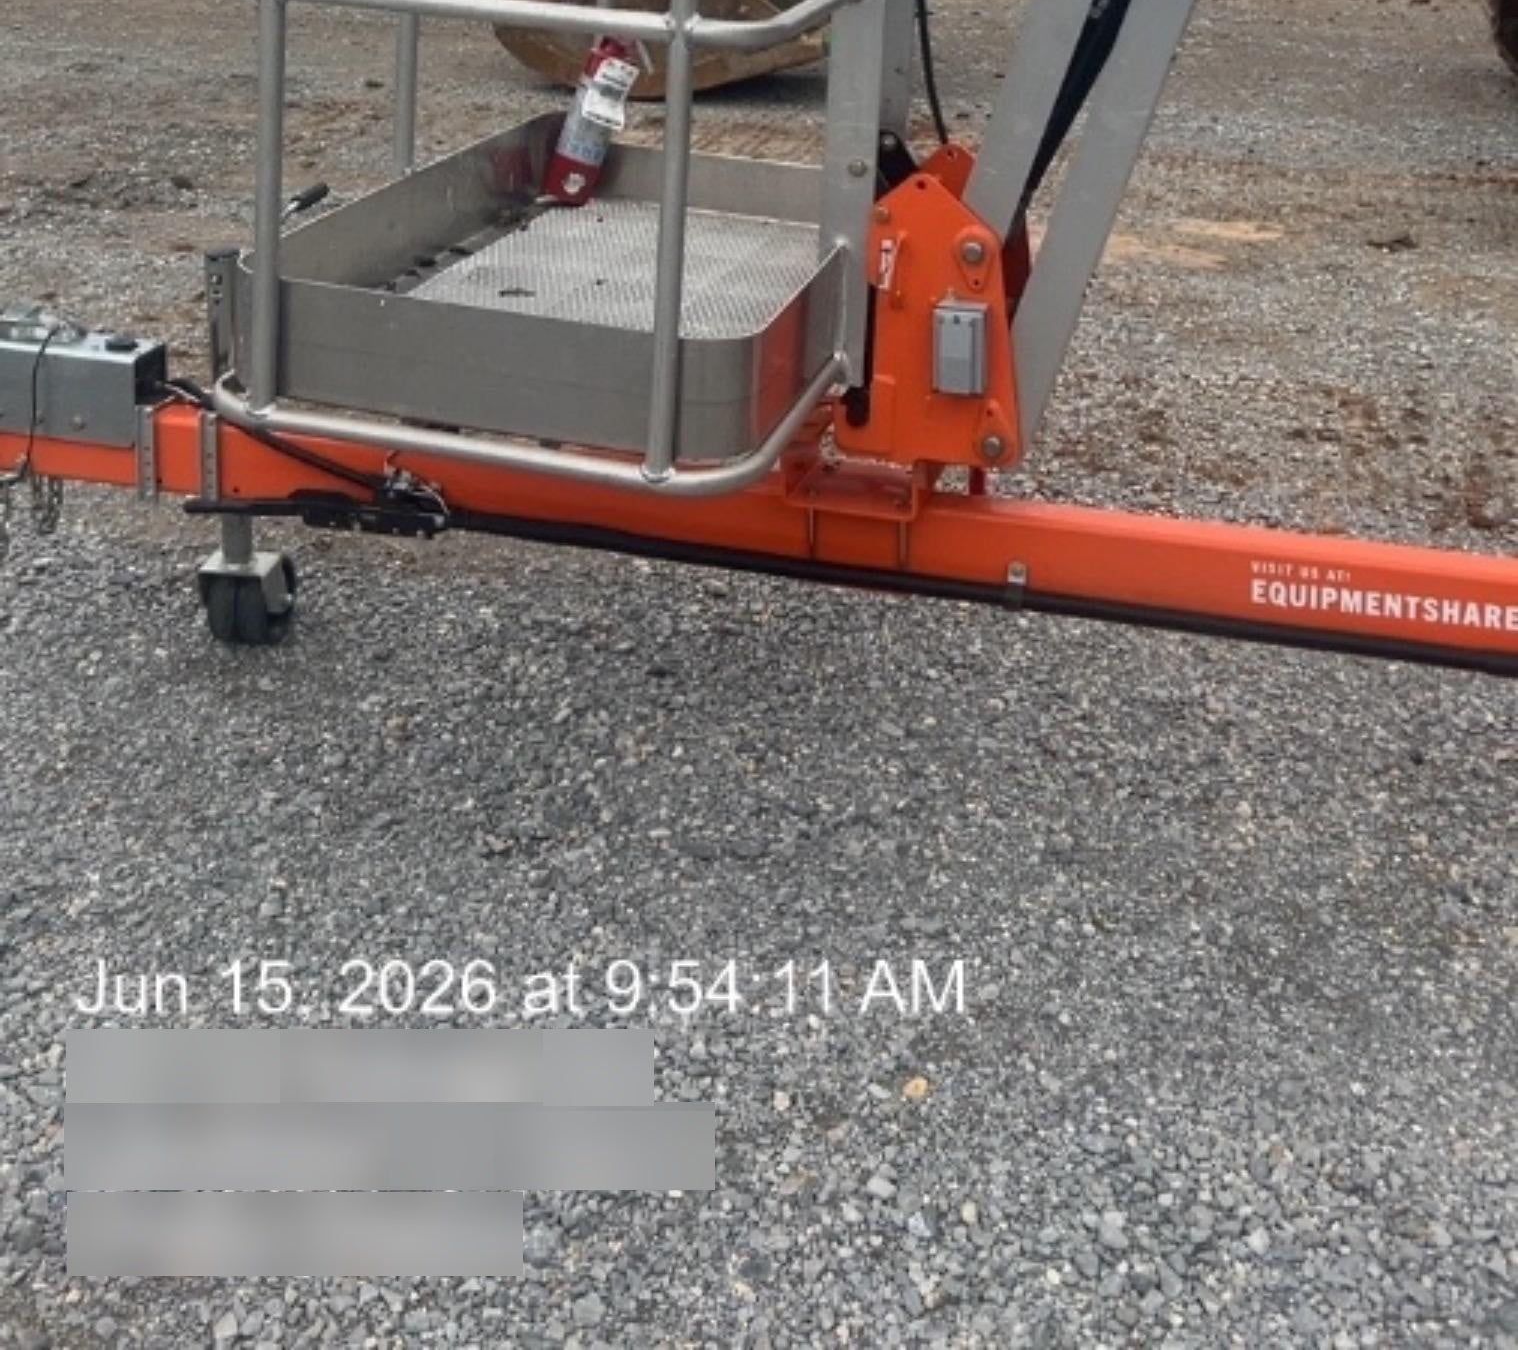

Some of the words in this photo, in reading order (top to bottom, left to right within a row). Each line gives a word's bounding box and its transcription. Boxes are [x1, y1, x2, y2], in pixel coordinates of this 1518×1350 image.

[1251, 560, 1292, 577] VISIT
[1301, 564, 1319, 580] US
[1252, 578, 1518, 631] EQUIPMENTSHARE
